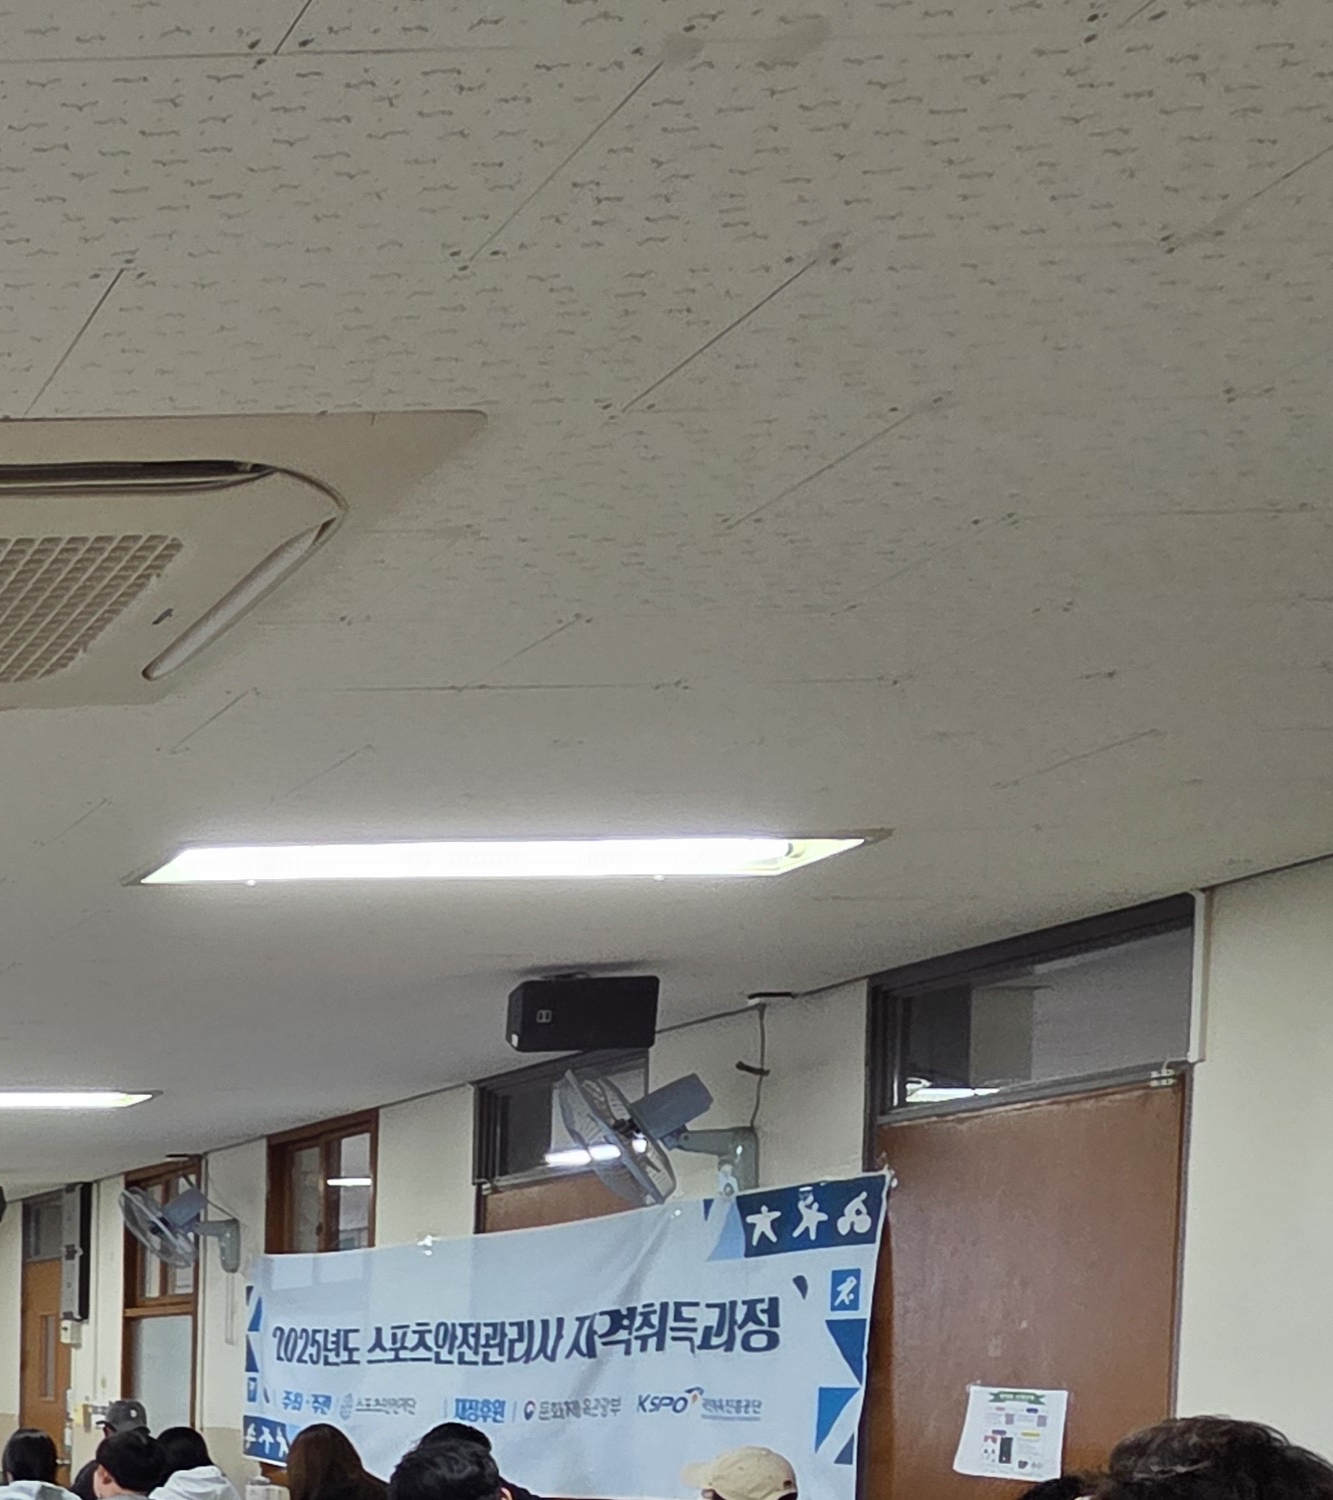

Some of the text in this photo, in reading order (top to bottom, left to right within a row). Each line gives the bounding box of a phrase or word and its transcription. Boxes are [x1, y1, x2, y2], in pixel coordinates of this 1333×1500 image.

[272, 1296, 781, 1367] 2025년도 스포츠안전관리사 자격취득과정
[636, 1394, 688, 1413] KSPO
